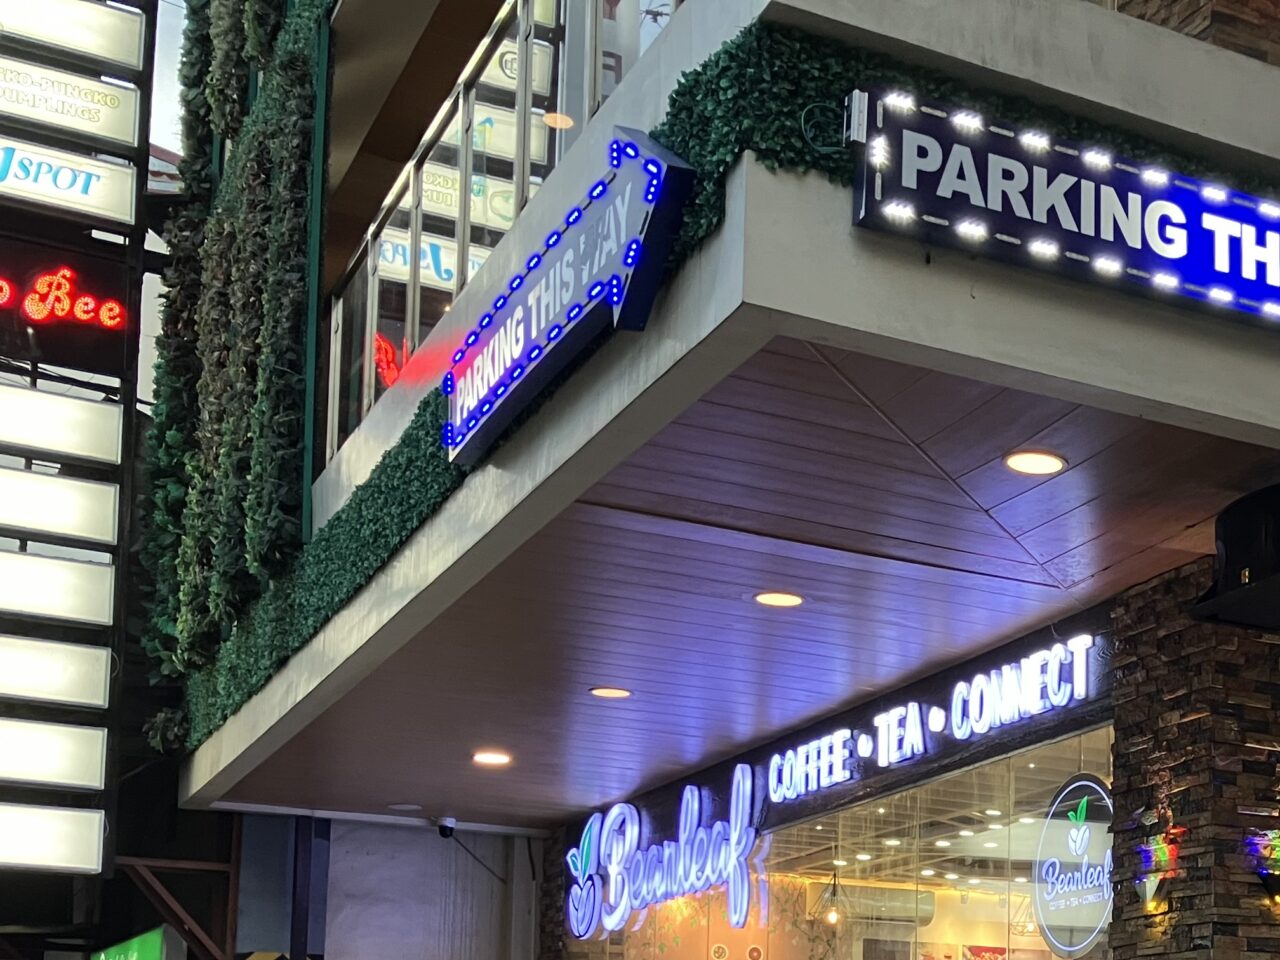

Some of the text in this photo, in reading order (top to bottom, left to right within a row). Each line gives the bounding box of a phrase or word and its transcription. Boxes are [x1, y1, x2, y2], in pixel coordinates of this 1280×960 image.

[0, 67, 120, 109] KO-PUNGKO
[900, 129, 1189, 260] PARKING
[24, 267, 121, 327] Bee
[455, 305, 524, 426] PARKING
[527, 248, 575, 339] THIS
[769, 634, 1093, 802] COFFEE TEA CONNECT
[600, 764, 757, 932] Beanleaf
[1042, 849, 1113, 901] Beanleaf
